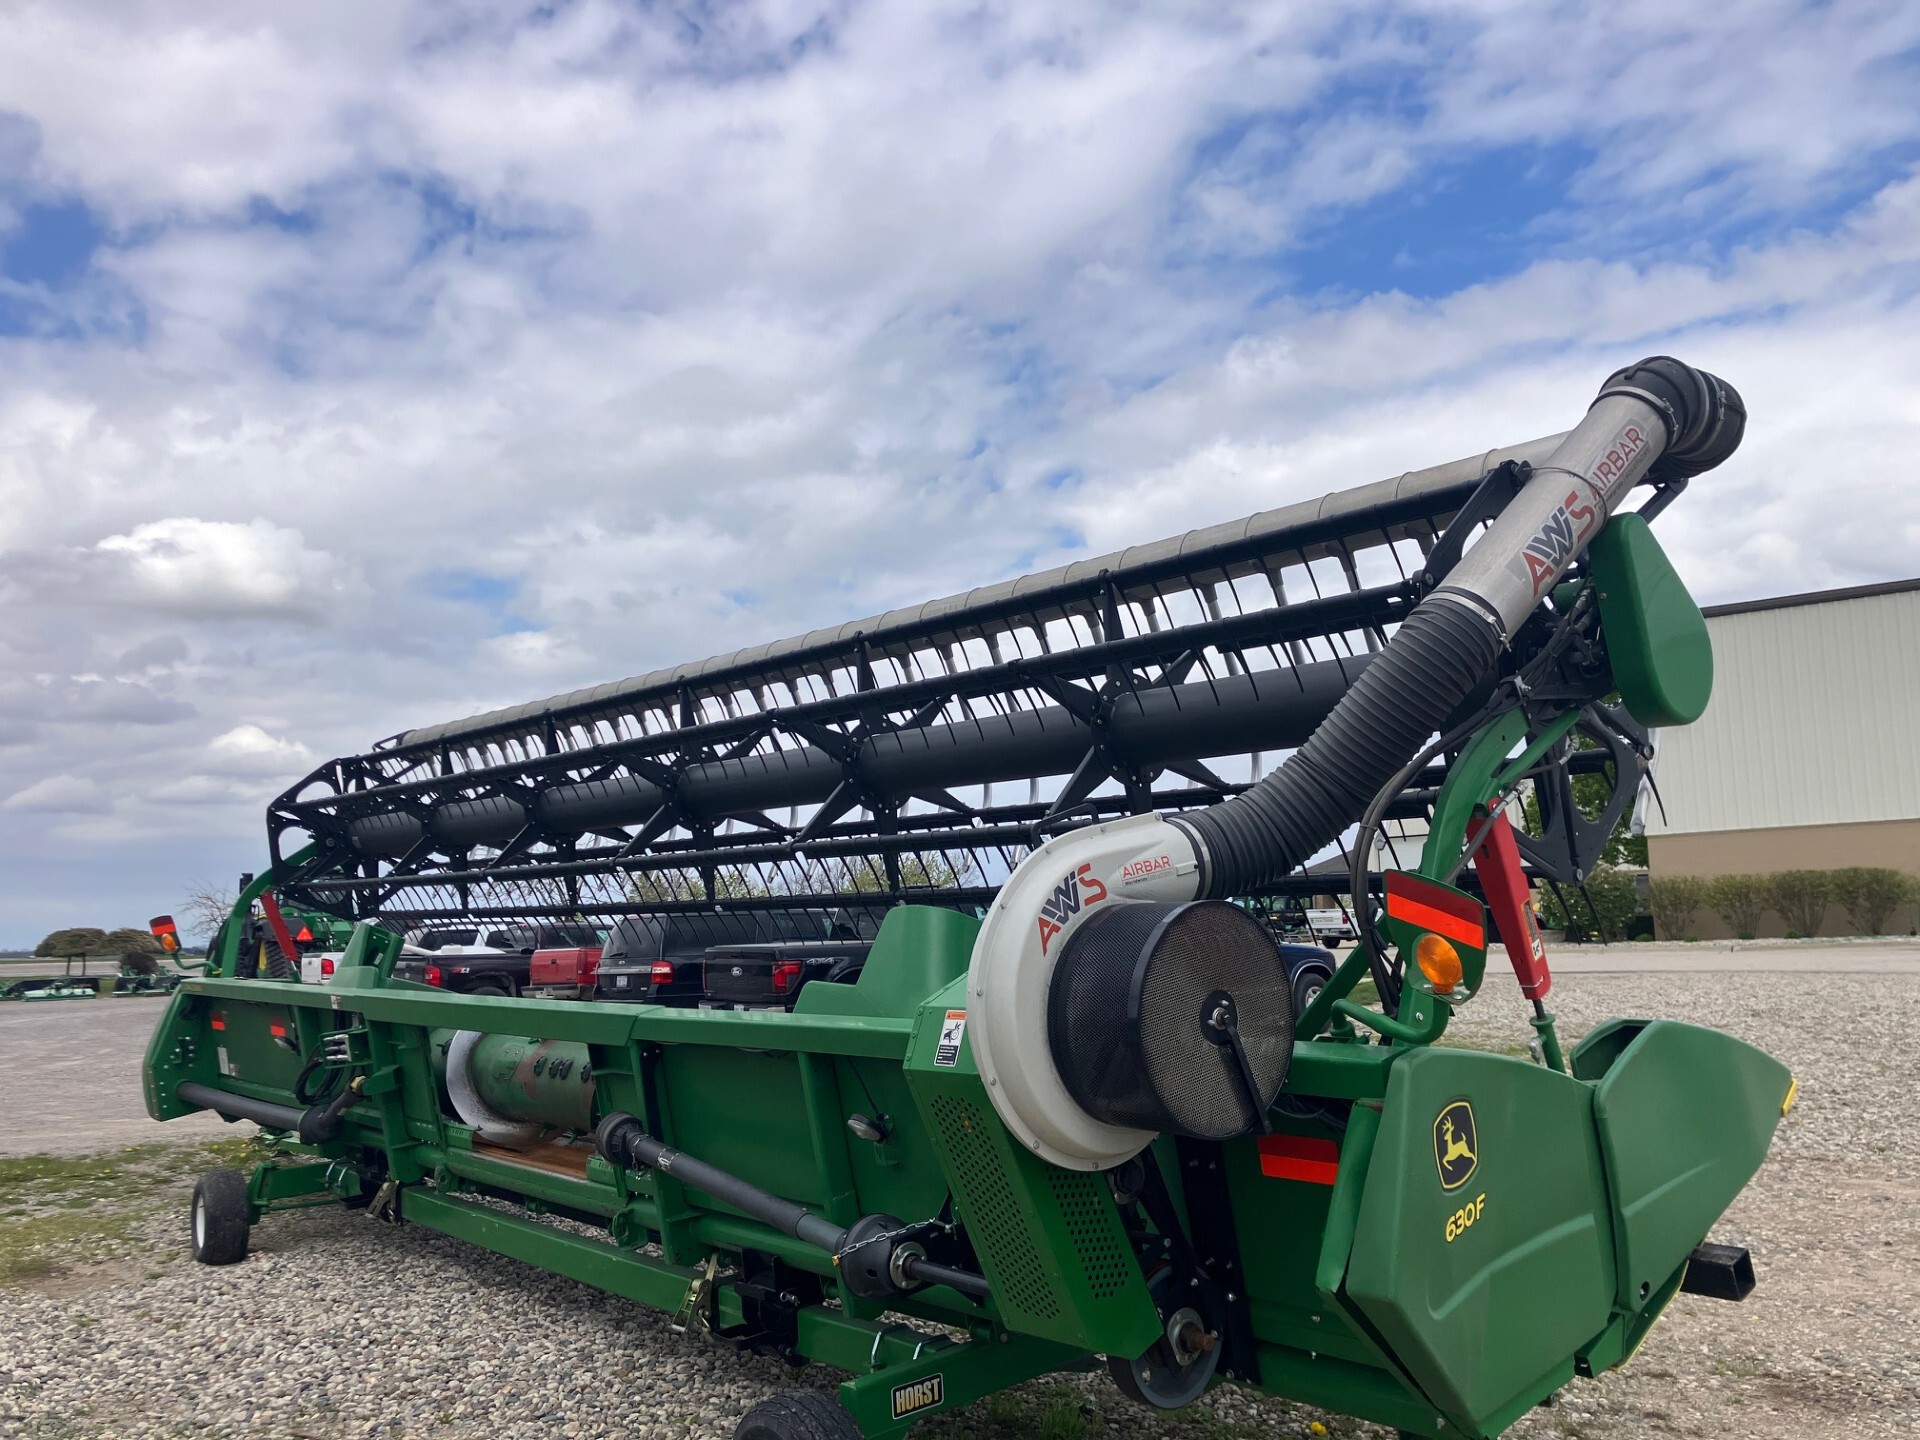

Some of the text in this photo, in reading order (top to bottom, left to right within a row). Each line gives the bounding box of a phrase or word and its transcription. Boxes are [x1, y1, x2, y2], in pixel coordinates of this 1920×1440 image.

[1591, 427, 1645, 501] AIRBAR
[1123, 856, 1171, 878] AIRBAR
[1445, 1193, 1486, 1242] 630F
[895, 1378, 940, 1414] HORST
